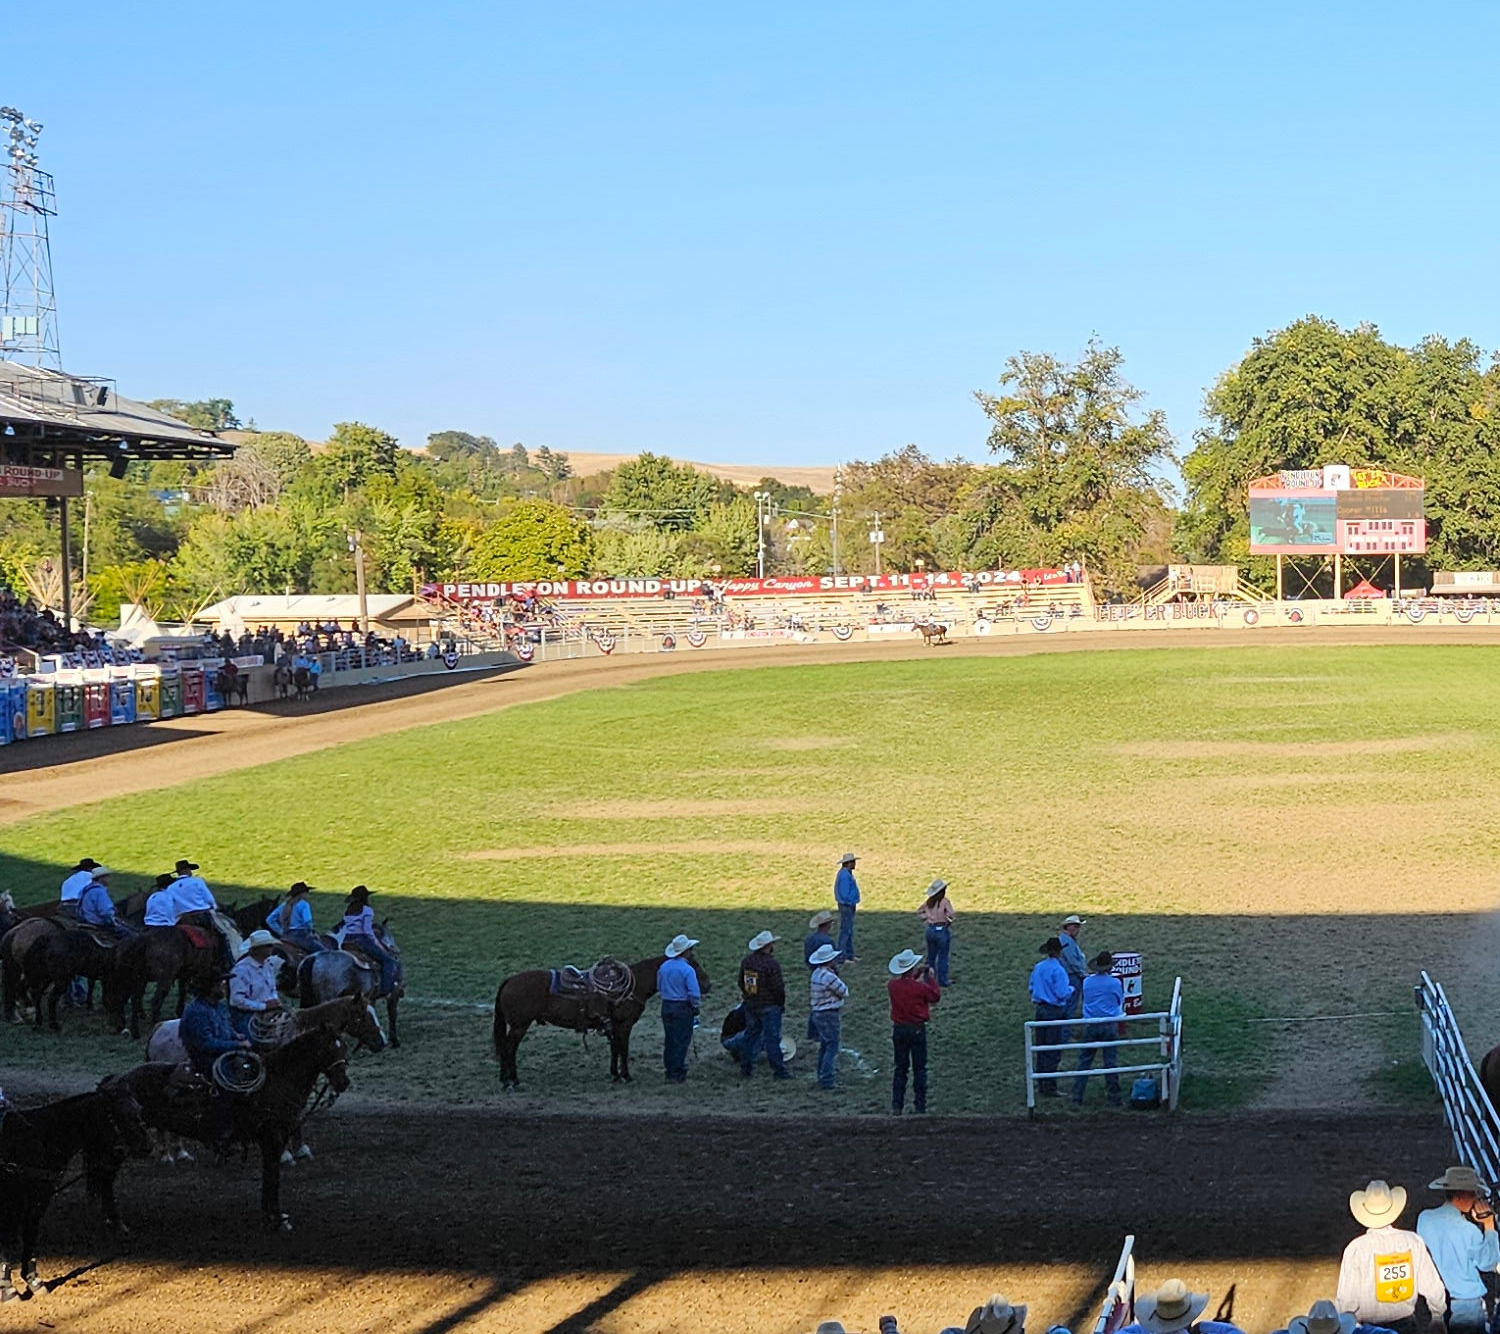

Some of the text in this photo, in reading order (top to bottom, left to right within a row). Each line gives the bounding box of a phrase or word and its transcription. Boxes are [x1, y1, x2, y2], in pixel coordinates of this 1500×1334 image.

[443, 581, 570, 598] PENDLETON
[576, 579, 701, 595] ROUND-UP
[716, 579, 759, 594] Happy
[763, 578, 814, 590] Canyon
[961, 570, 1020, 584] 2024
[1172, 603, 1219, 620] BUCK
[1383, 1265, 1407, 1280] 255
